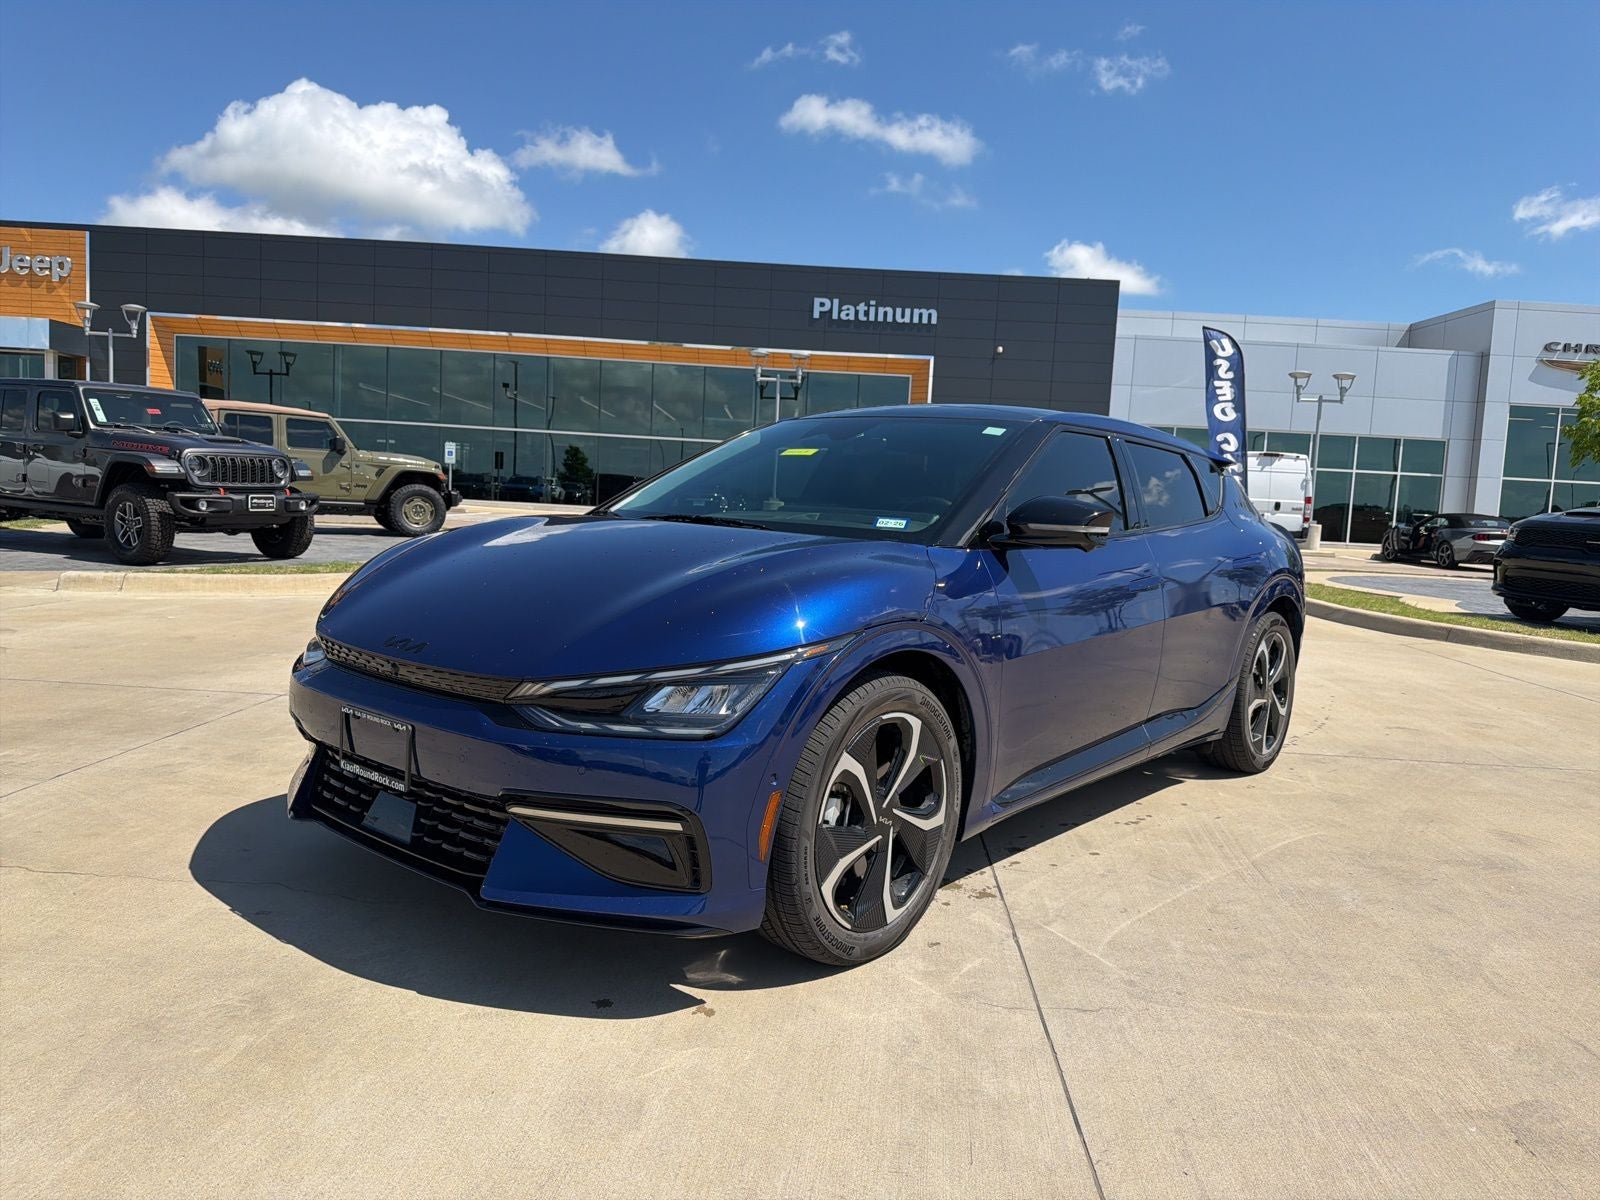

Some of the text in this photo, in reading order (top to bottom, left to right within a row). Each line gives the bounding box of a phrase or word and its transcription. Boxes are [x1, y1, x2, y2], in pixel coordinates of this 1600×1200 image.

[0, 245, 72, 282] Jeep
[812, 297, 938, 325] Platinum
[1543, 341, 1600, 354] CHR
[340, 759, 405, 792] KiaofRoundRock.com
